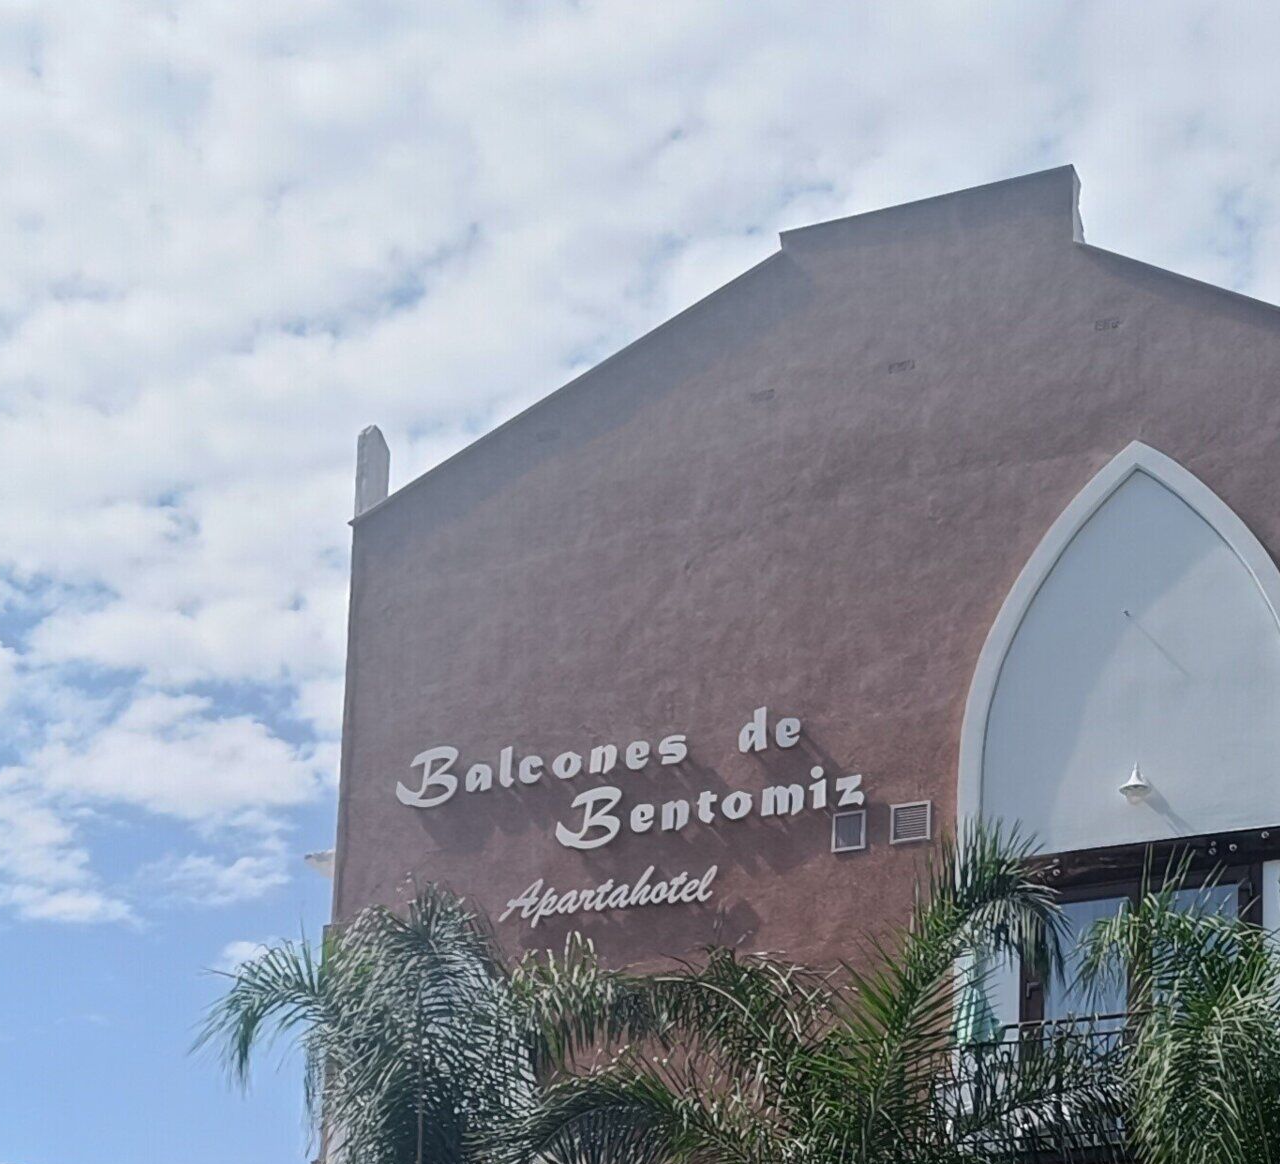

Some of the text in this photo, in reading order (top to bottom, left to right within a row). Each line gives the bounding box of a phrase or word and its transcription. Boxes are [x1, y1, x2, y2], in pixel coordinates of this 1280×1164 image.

[396, 706, 802, 807] Balcones de
[556, 765, 866, 849] Bentomiz
[498, 864, 718, 927] Apartahotel
